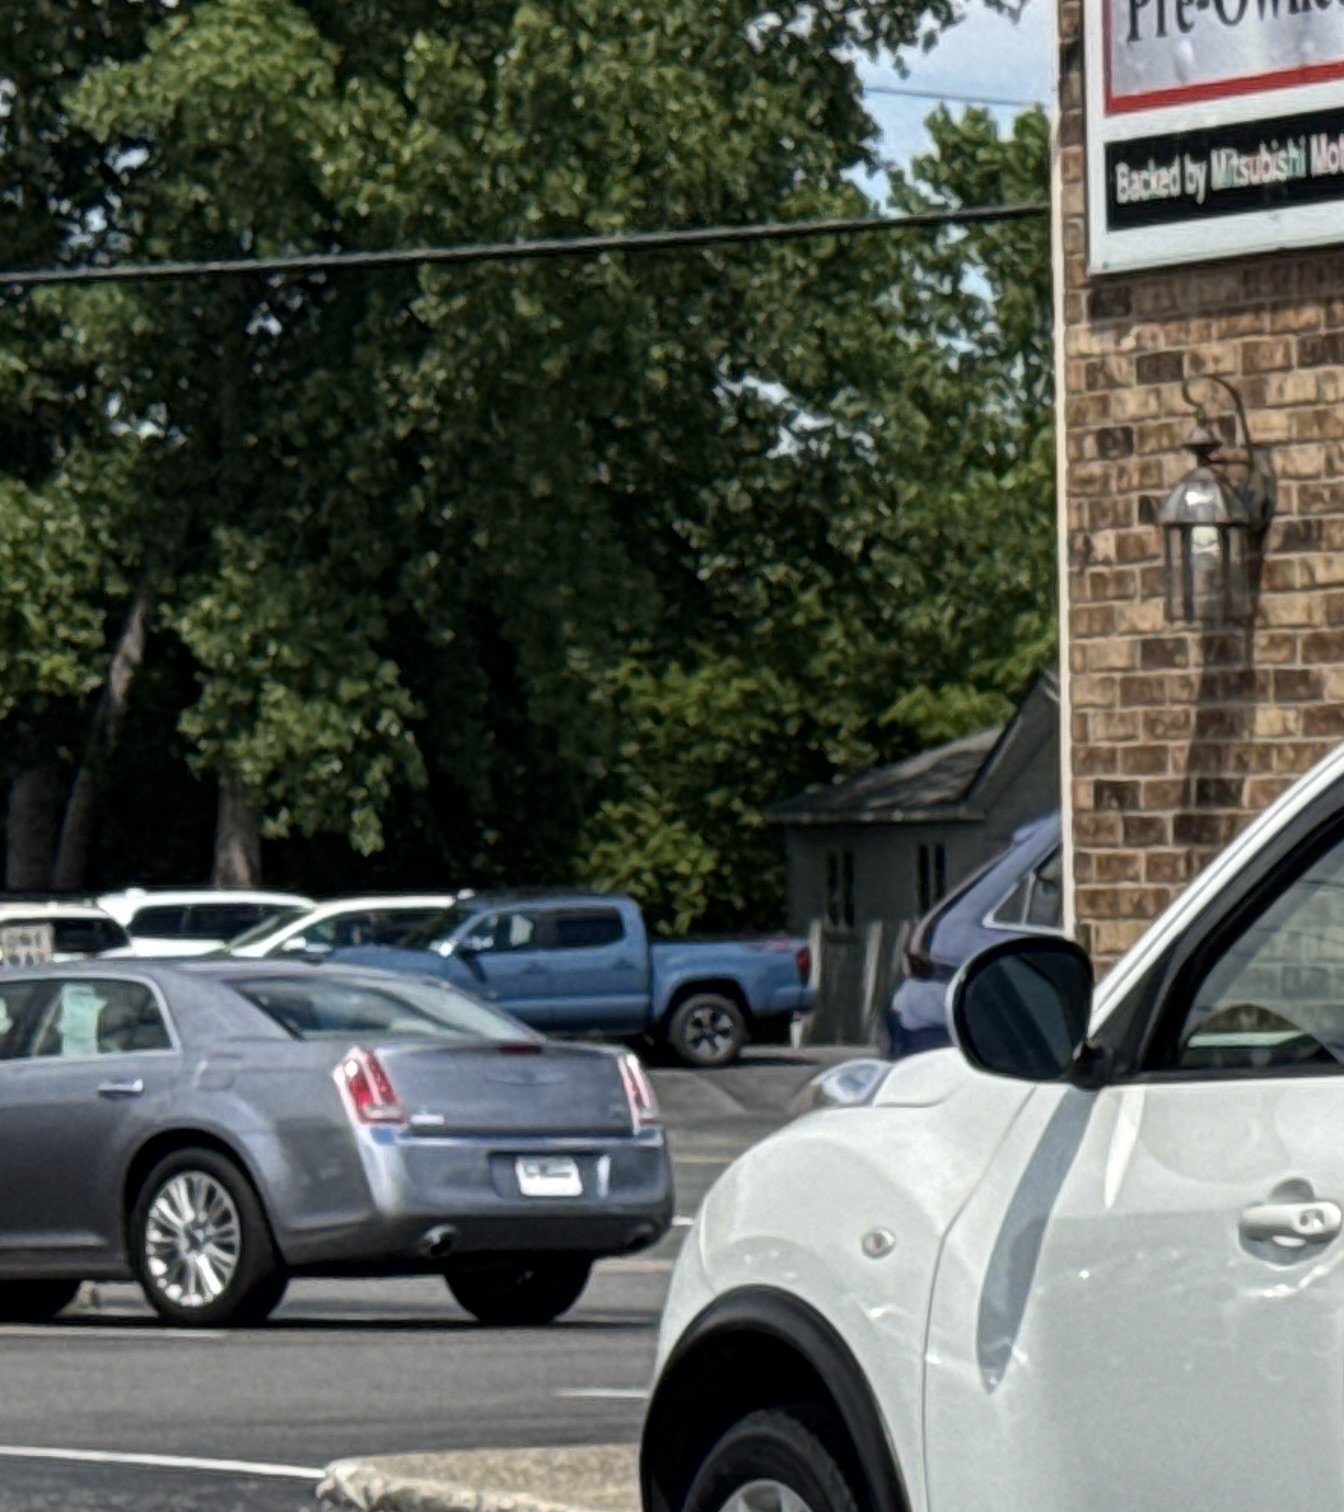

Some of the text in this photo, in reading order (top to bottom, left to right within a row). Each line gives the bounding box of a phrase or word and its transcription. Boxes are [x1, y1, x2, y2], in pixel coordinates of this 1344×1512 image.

[1114, 153, 1183, 205] Backed
[1183, 151, 1209, 206] by
[1210, 136, 1307, 192] Mitsubishi
